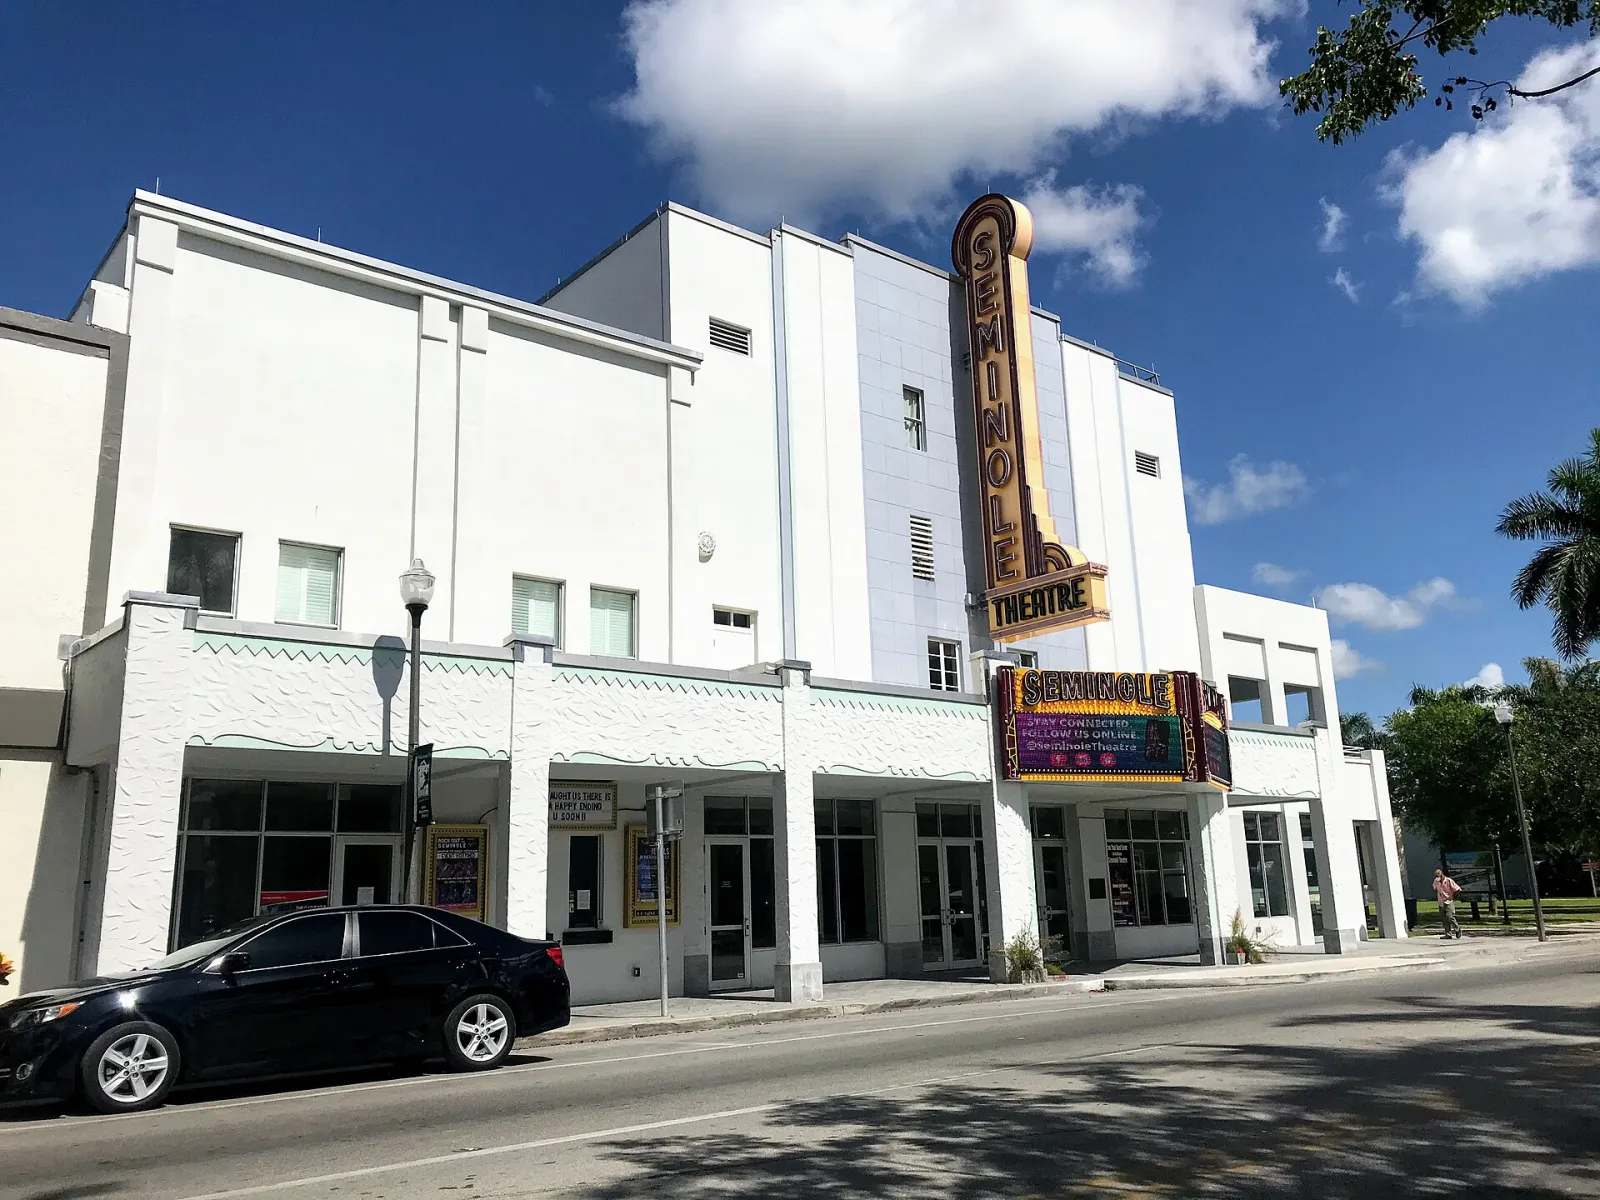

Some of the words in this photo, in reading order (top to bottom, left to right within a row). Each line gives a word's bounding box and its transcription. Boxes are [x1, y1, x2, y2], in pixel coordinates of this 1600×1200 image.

[973, 231, 1017, 582] SEMINOLE
[991, 577, 1087, 627] THEATRE
[1023, 670, 1170, 710] SEMINOLE
[1027, 718, 1056, 727] STAY
[1022, 729, 1072, 738] FOLLOW
[1075, 730, 1089, 738] US
[1026, 742, 1137, 752] @SeminoleTheatre
[573, 792, 581, 800] US
[583, 792, 602, 801] THERE
[604, 792, 611, 801] IS
[555, 802, 577, 811] HAPPY
[580, 802, 602, 811] ENDING
[553, 812, 558, 821] U
